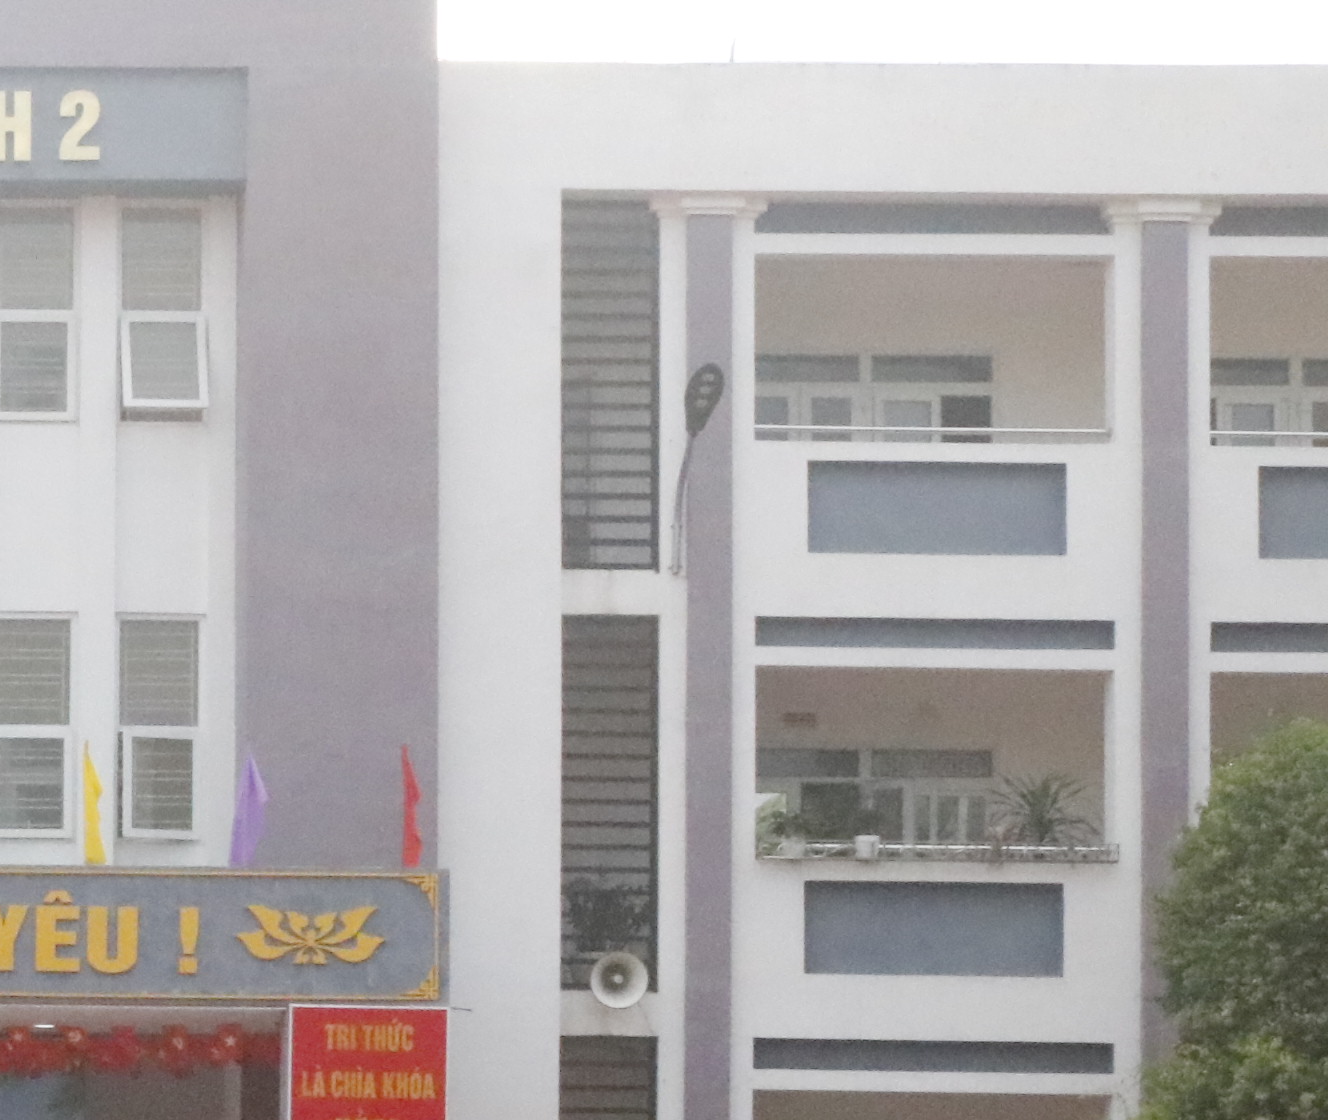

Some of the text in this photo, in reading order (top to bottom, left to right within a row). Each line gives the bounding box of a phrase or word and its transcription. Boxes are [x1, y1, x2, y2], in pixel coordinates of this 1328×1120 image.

[59, 90, 103, 163] 2
[177, 906, 201, 974] !
[362, 1018, 415, 1052] THỨC
[302, 1064, 436, 1100] LÀ CHÌA KHÓA
